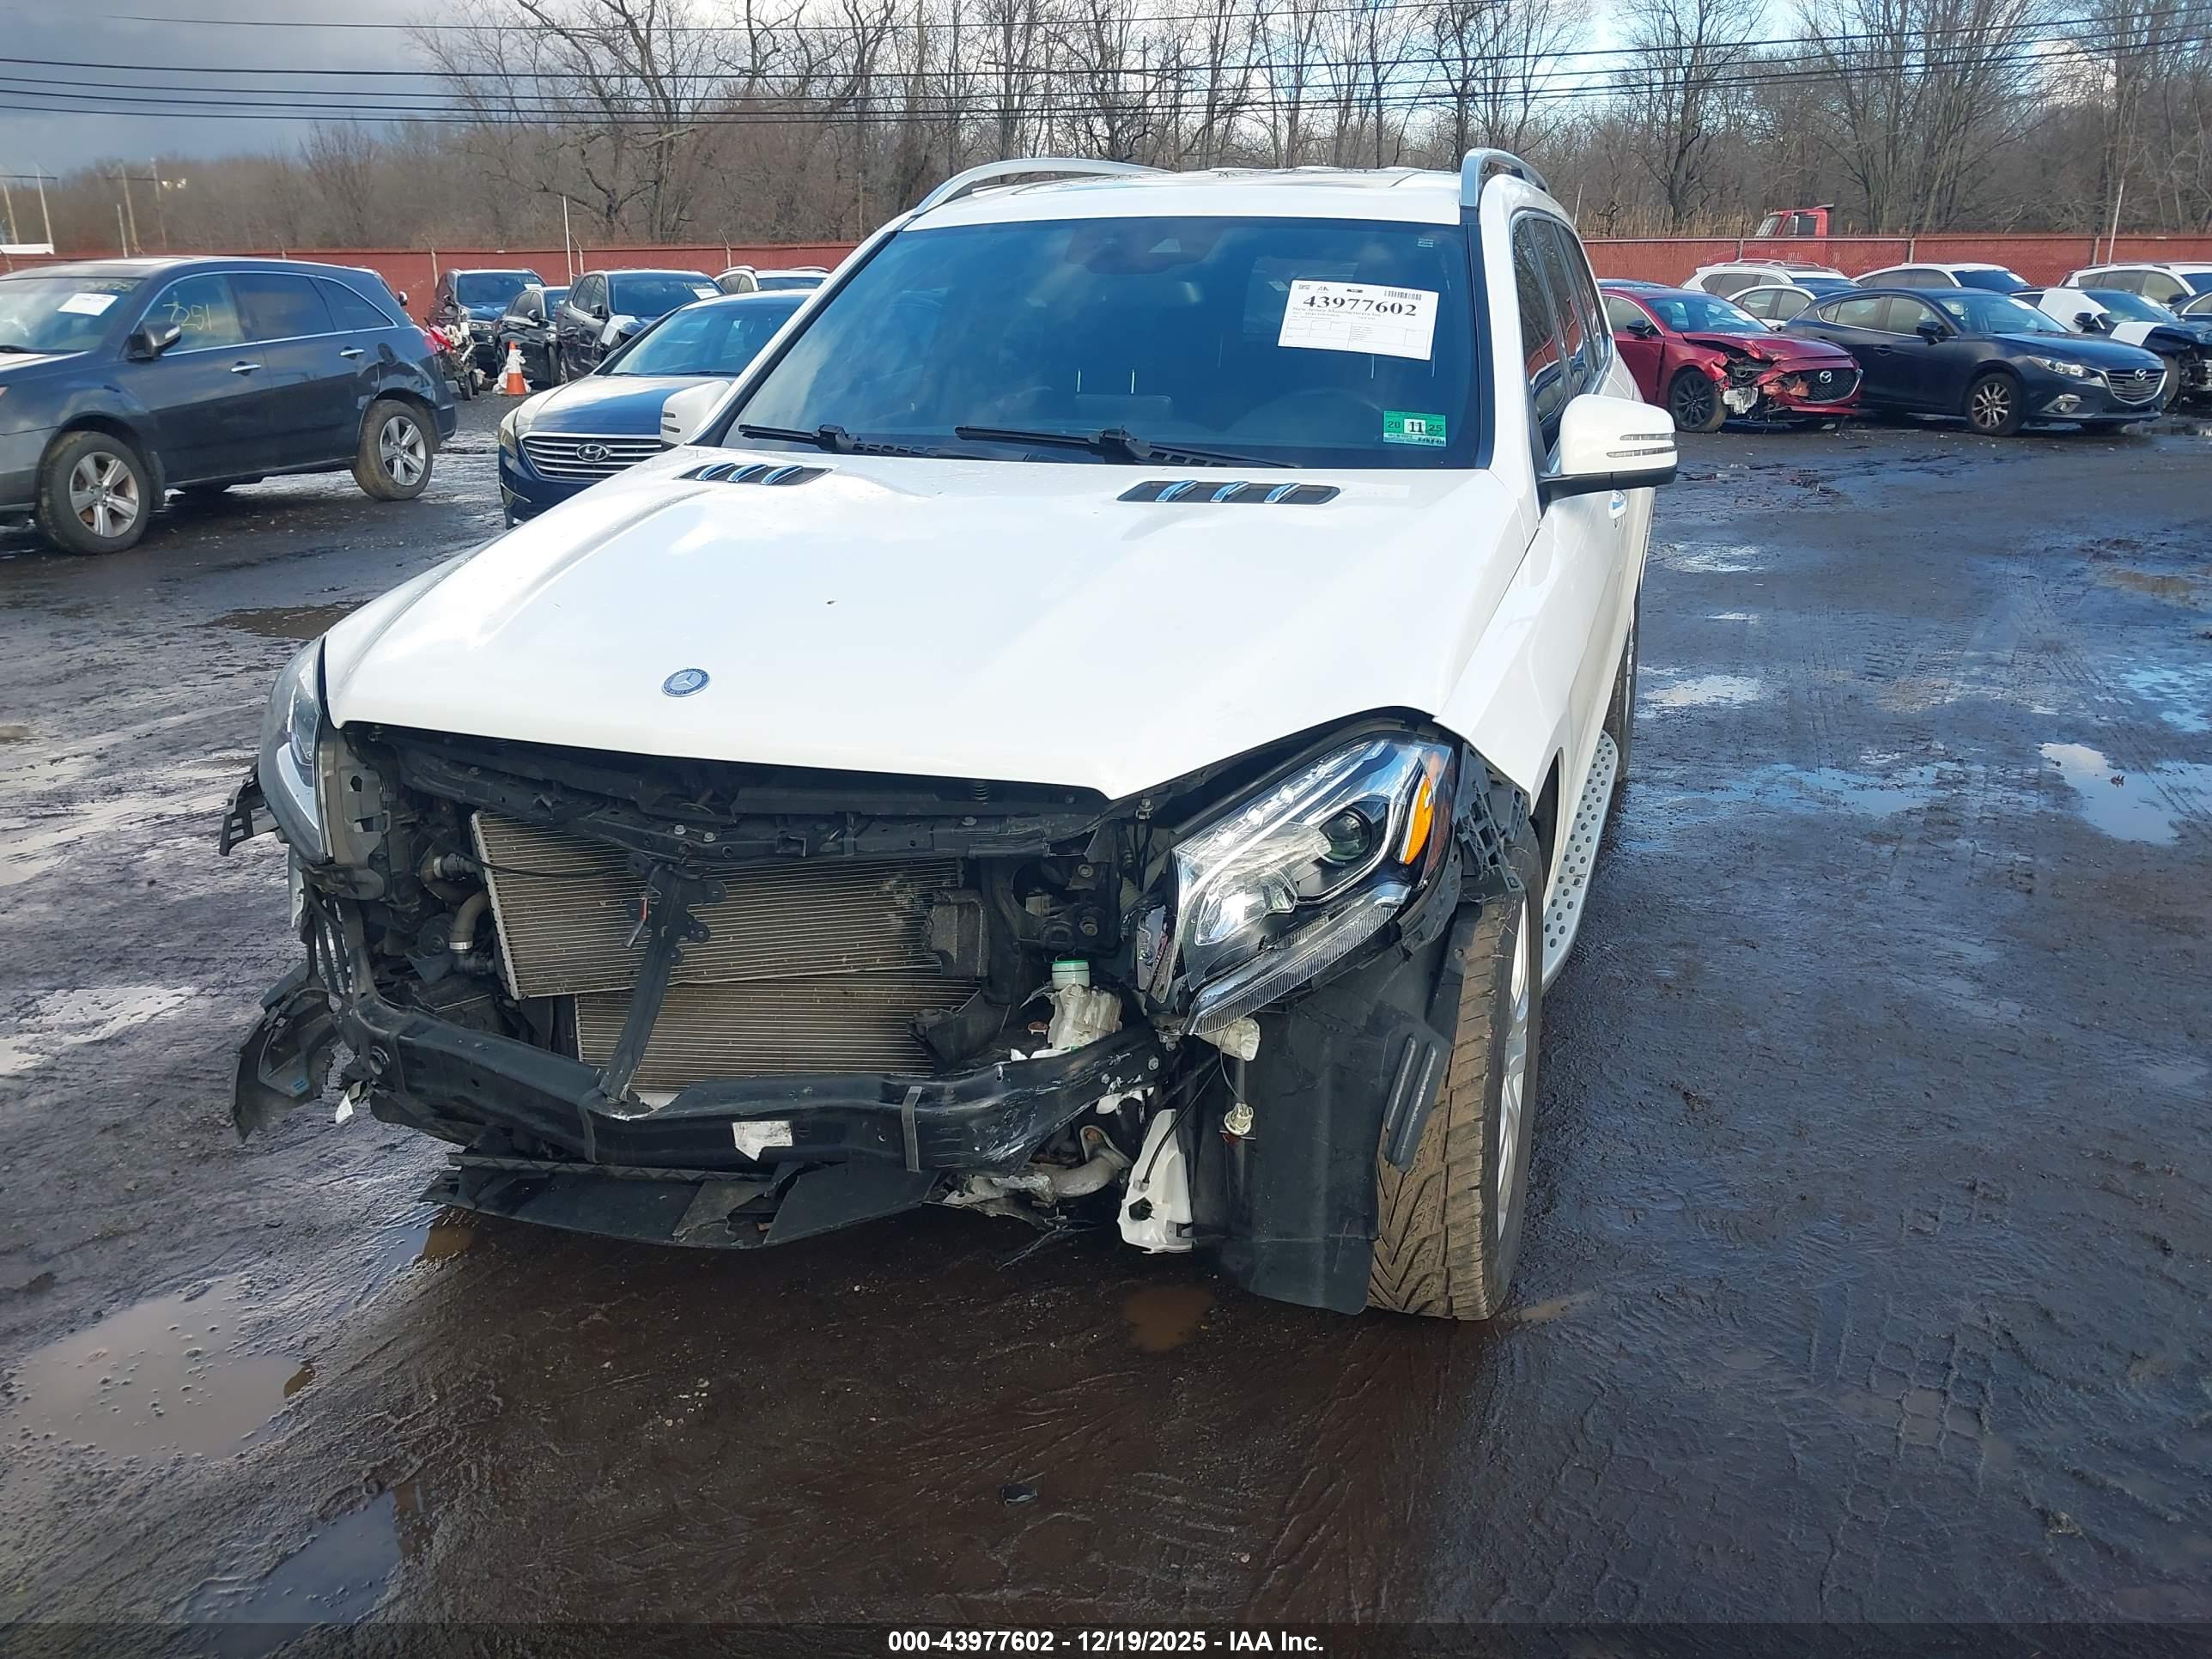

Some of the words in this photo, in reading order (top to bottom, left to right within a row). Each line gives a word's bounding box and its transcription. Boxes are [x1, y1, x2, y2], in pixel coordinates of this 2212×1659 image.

[162, 302, 212, 331] 7251
[1303, 295, 1417, 317] 43977602
[1408, 421, 1424, 434] 11
